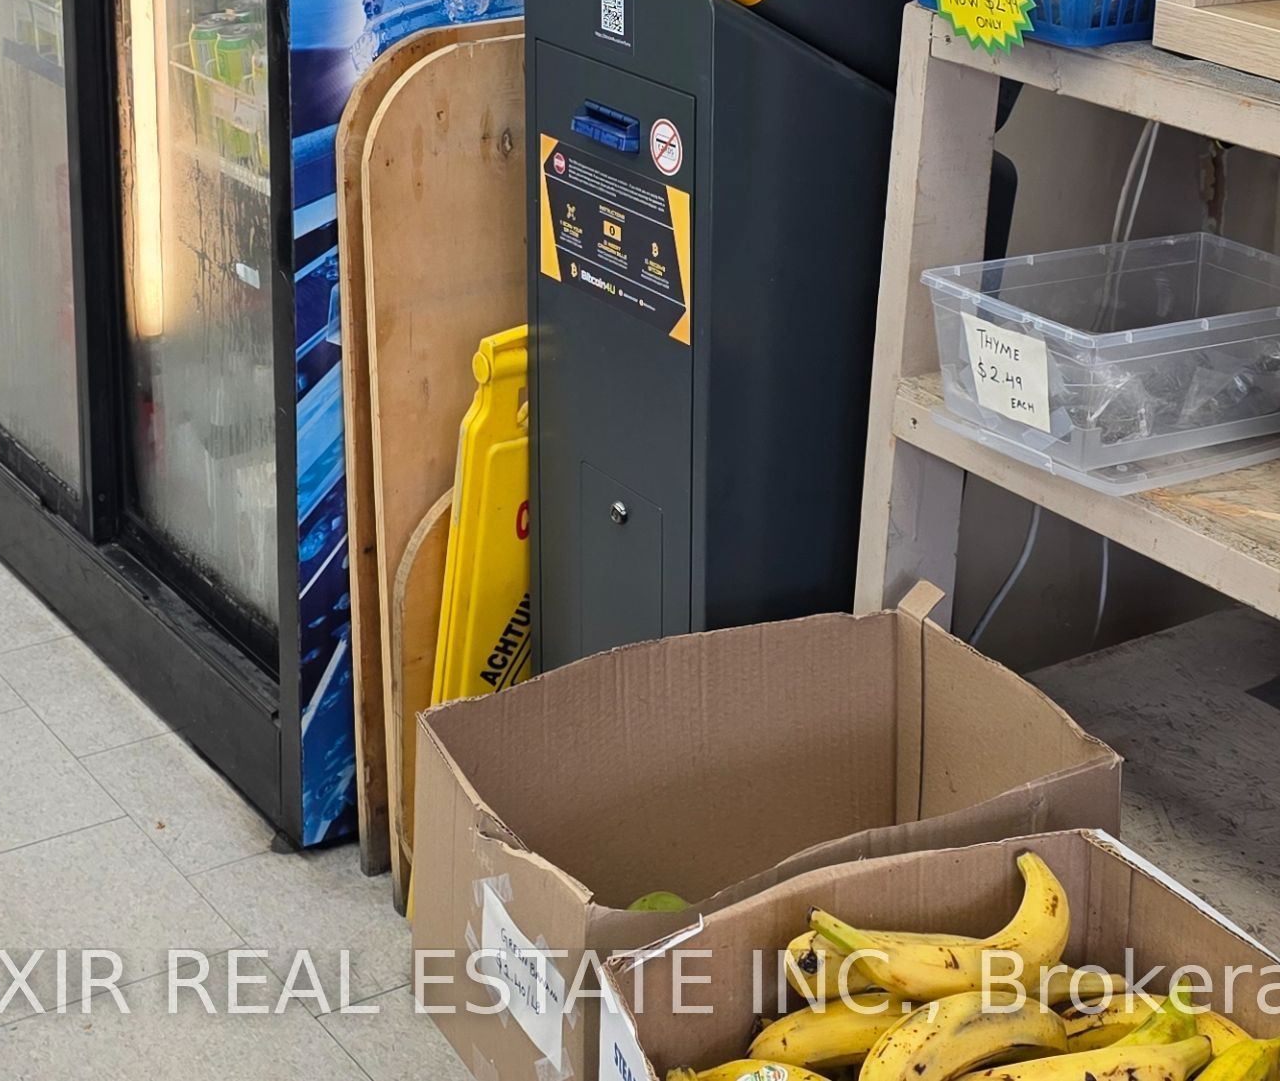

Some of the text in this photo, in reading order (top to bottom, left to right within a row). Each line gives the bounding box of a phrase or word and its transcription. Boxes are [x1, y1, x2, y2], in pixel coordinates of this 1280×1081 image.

[976, 16, 1002, 30] ONLY
[976, 328, 1020, 361] THYME
[976, 356, 1022, 391] $2.49
[1011, 397, 1035, 413] EACH
